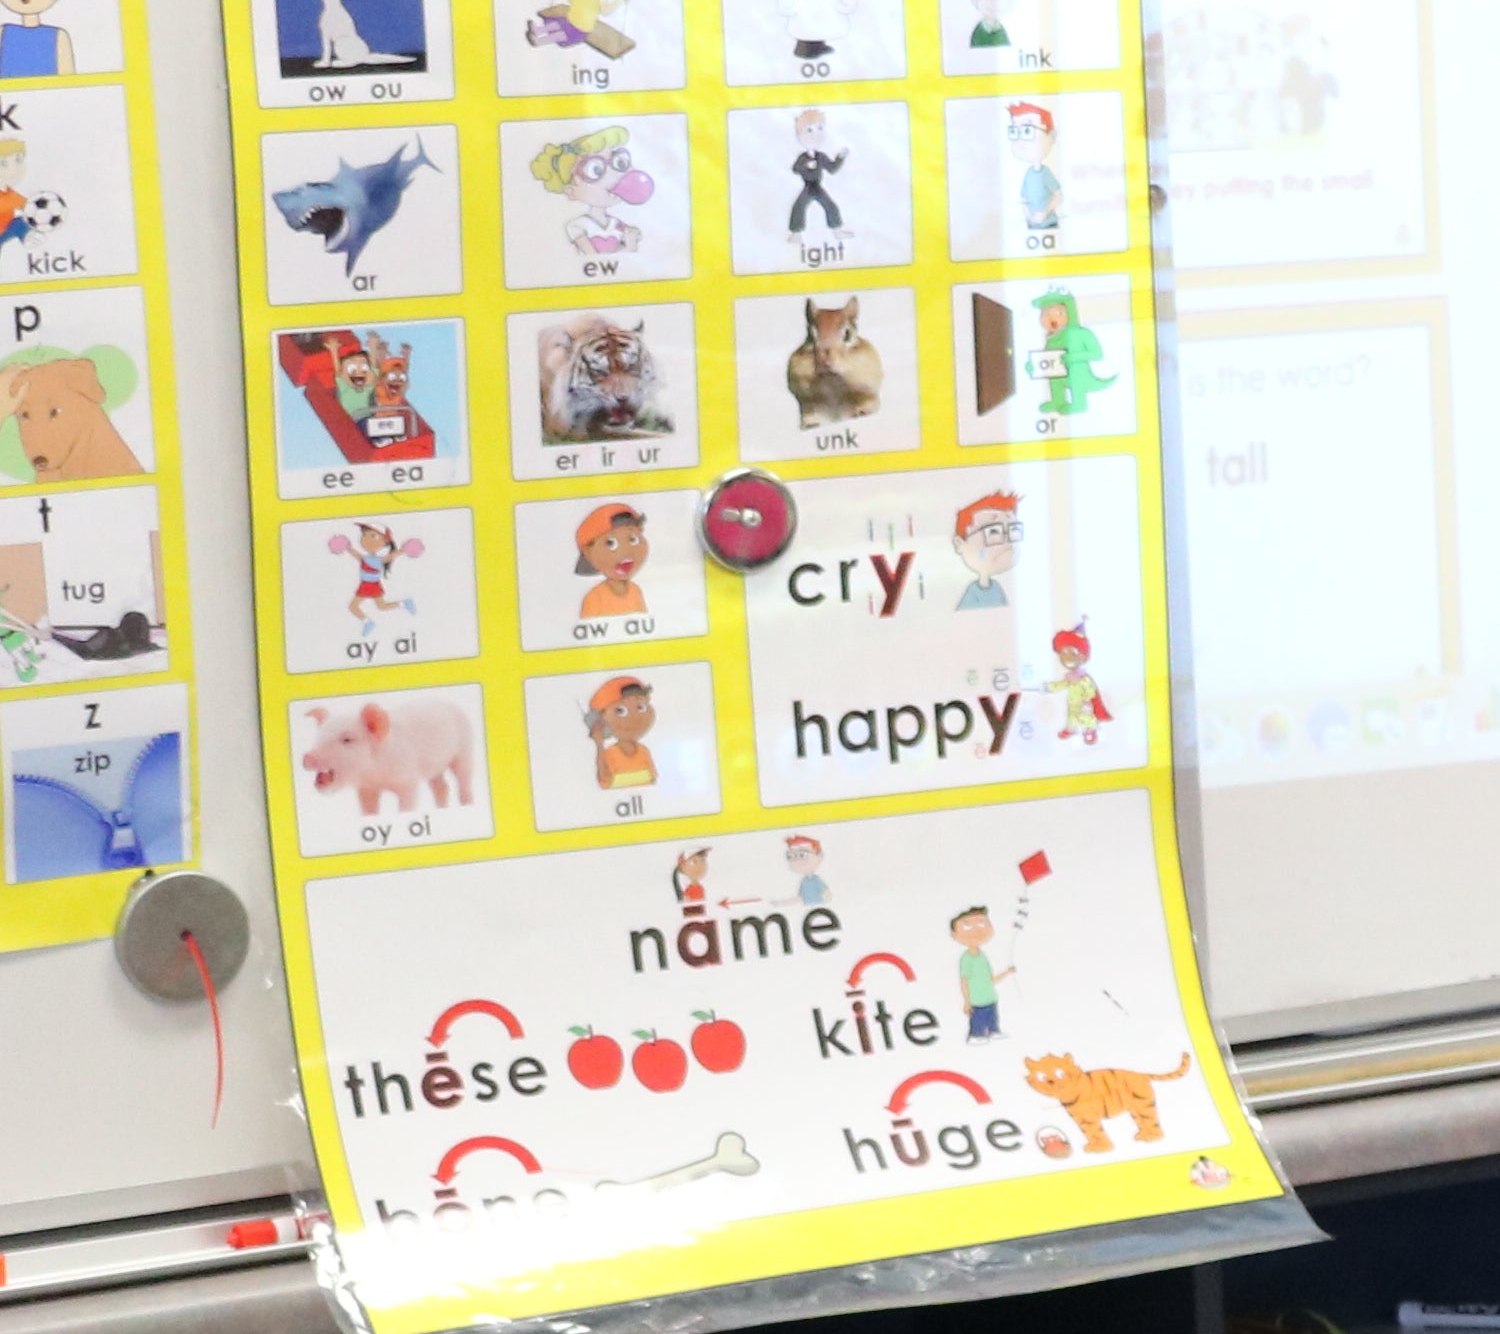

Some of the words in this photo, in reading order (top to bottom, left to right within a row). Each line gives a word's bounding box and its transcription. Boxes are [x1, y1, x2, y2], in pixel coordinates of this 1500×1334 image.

[572, 64, 610, 88] ing
[1018, 48, 1052, 69] ink
[27, 249, 87, 275] kick
[801, 242, 845, 266] ight
[816, 429, 859, 452] unk
[62, 578, 106, 604] tug
[788, 552, 916, 618] cry
[793, 691, 1022, 765] happy
[73, 751, 112, 776] zip
[614, 795, 644, 818] all
